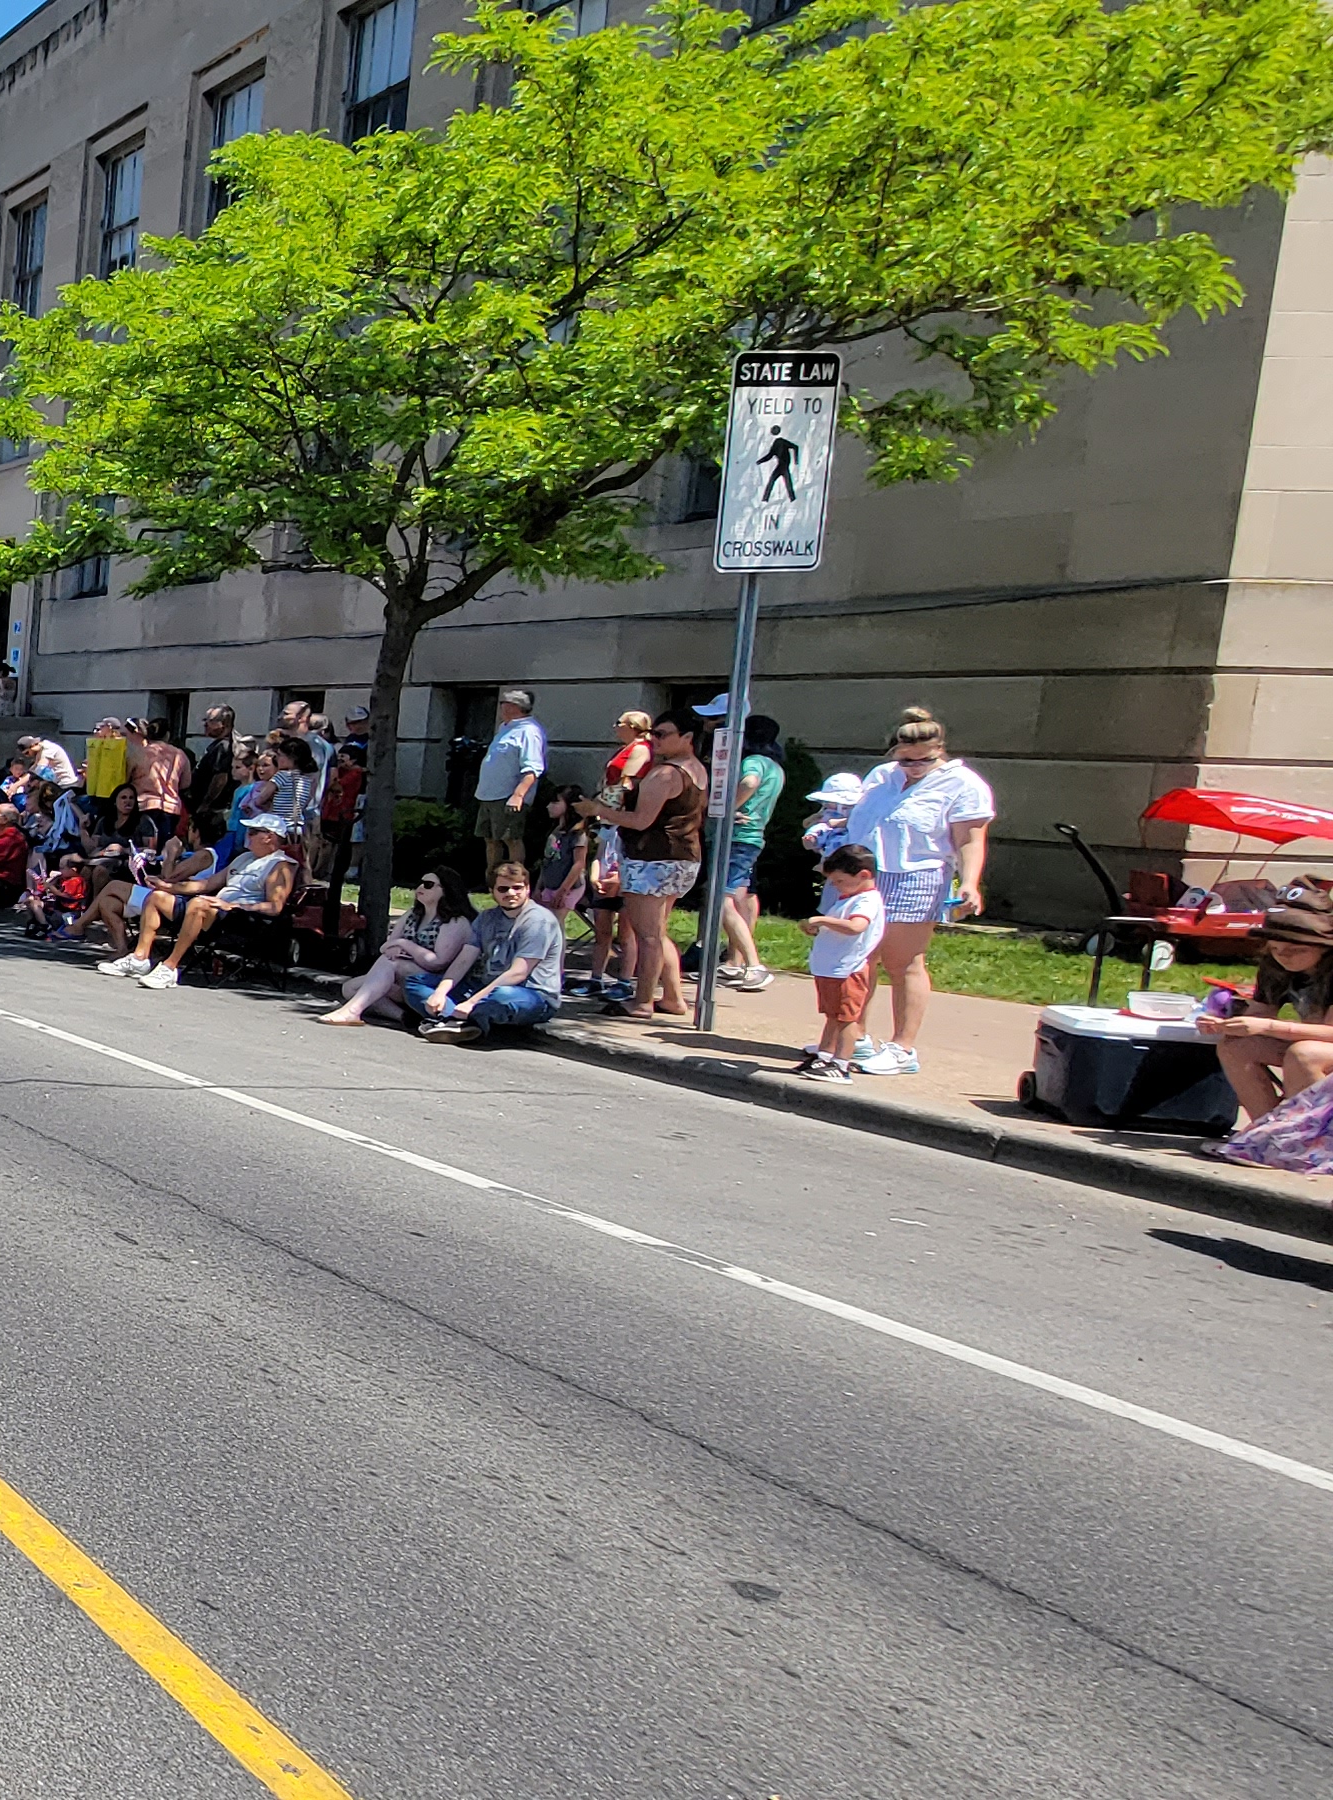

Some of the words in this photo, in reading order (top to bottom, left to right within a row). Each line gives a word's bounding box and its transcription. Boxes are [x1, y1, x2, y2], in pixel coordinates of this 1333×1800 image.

[739, 362, 792, 381] STATE
[800, 362, 835, 381] LAW
[747, 397, 793, 415] YIELD
[803, 397, 822, 415] TO
[763, 514, 779, 531] IN
[722, 540, 815, 559] CROSSWALK
